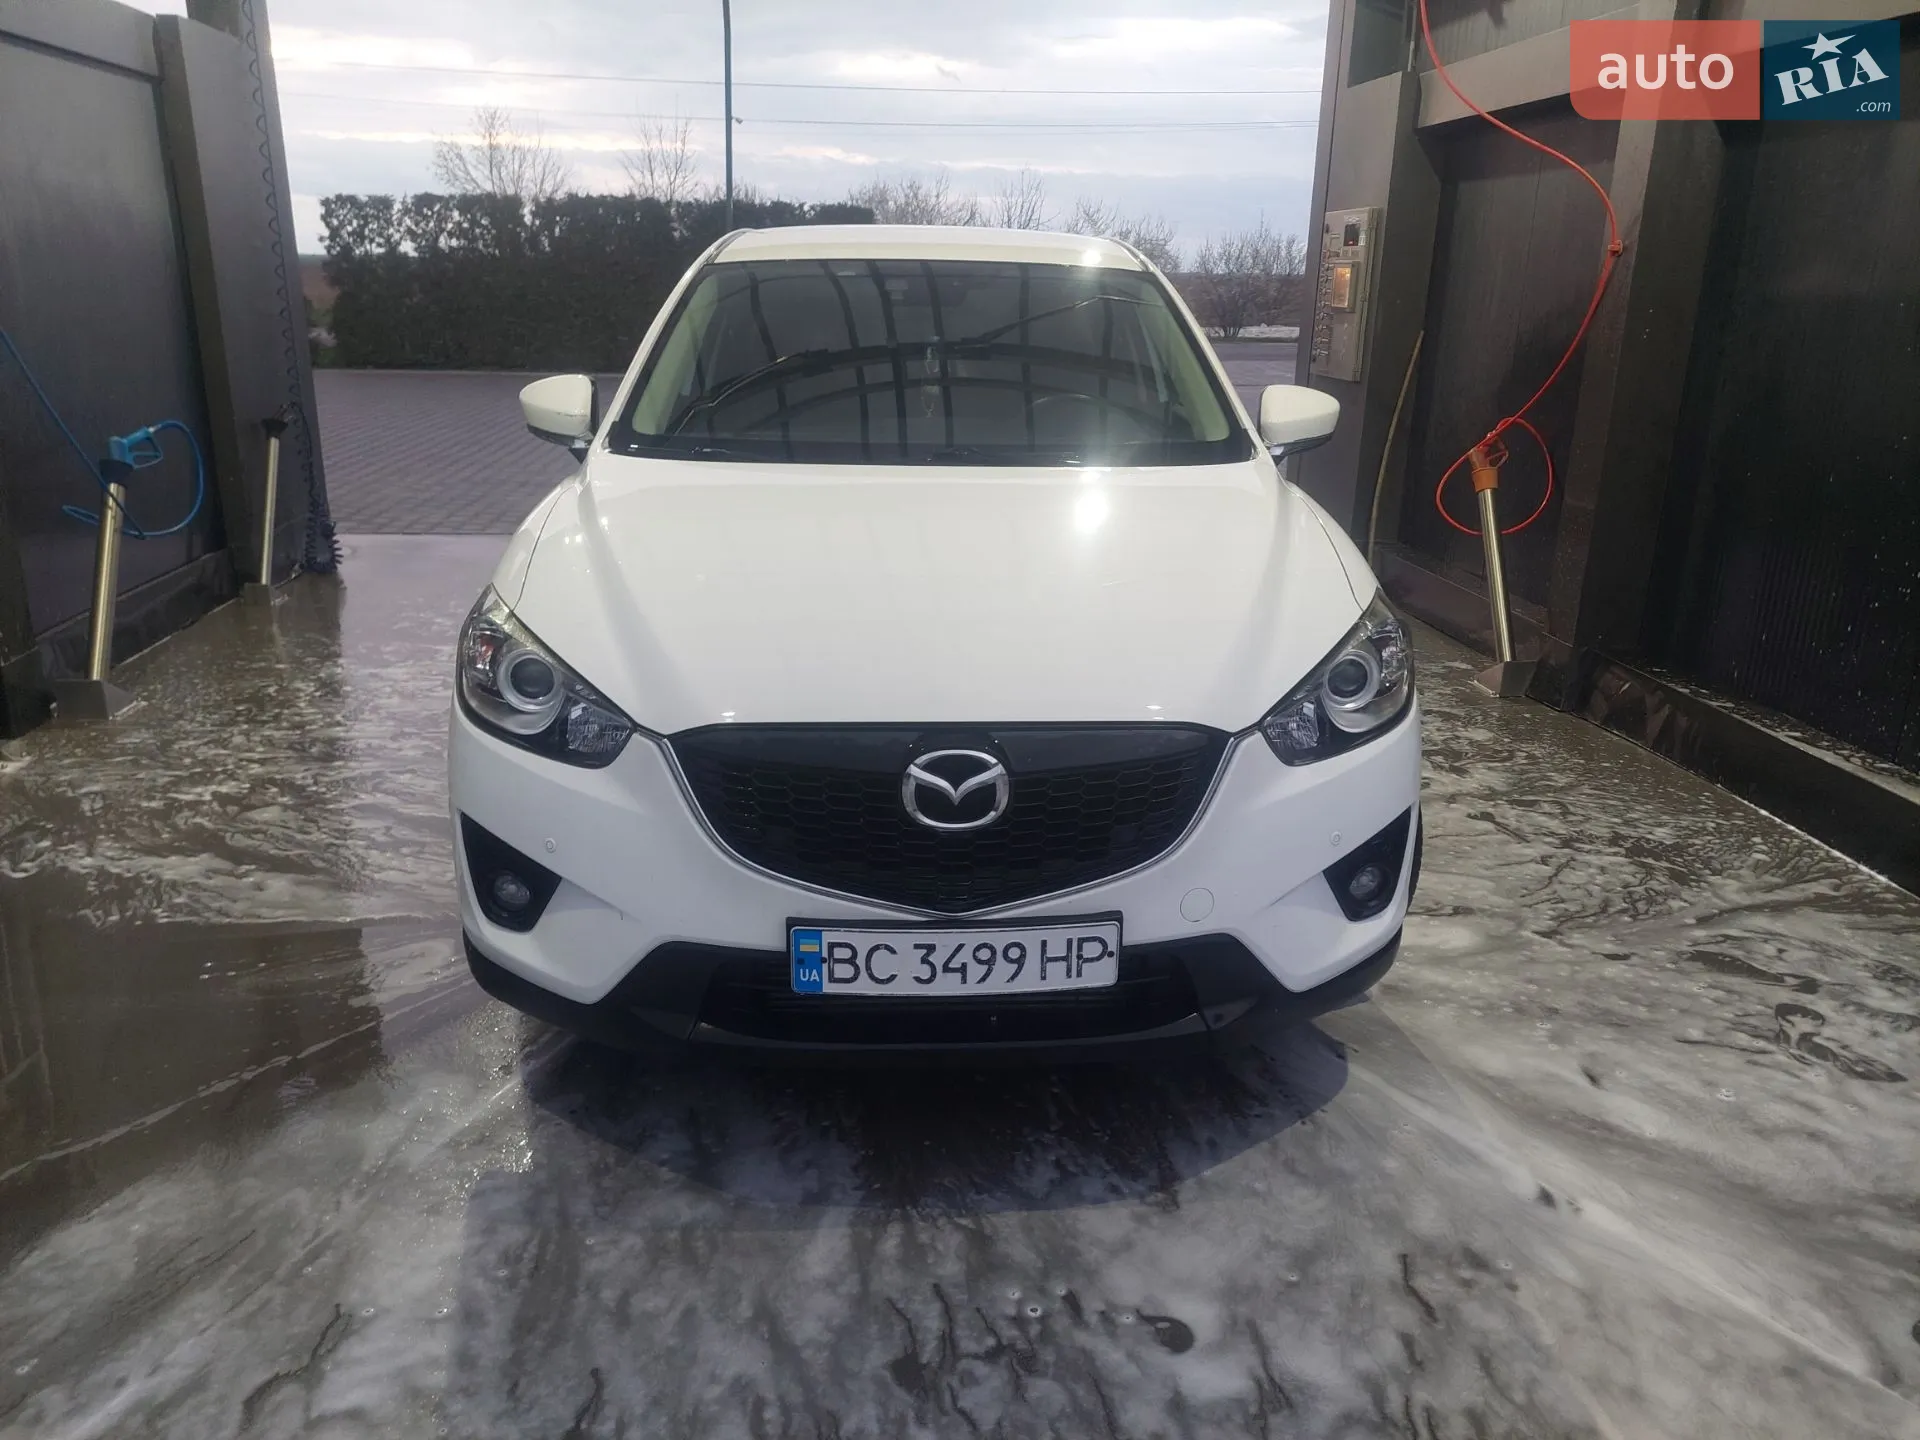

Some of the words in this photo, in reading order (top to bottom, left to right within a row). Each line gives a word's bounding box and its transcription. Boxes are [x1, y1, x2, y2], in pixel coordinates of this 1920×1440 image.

[800, 968, 820, 982] UA
[827, 941, 899, 985] BC
[912, 942, 1028, 985] 3499
[1040, 936, 1109, 981] HP
